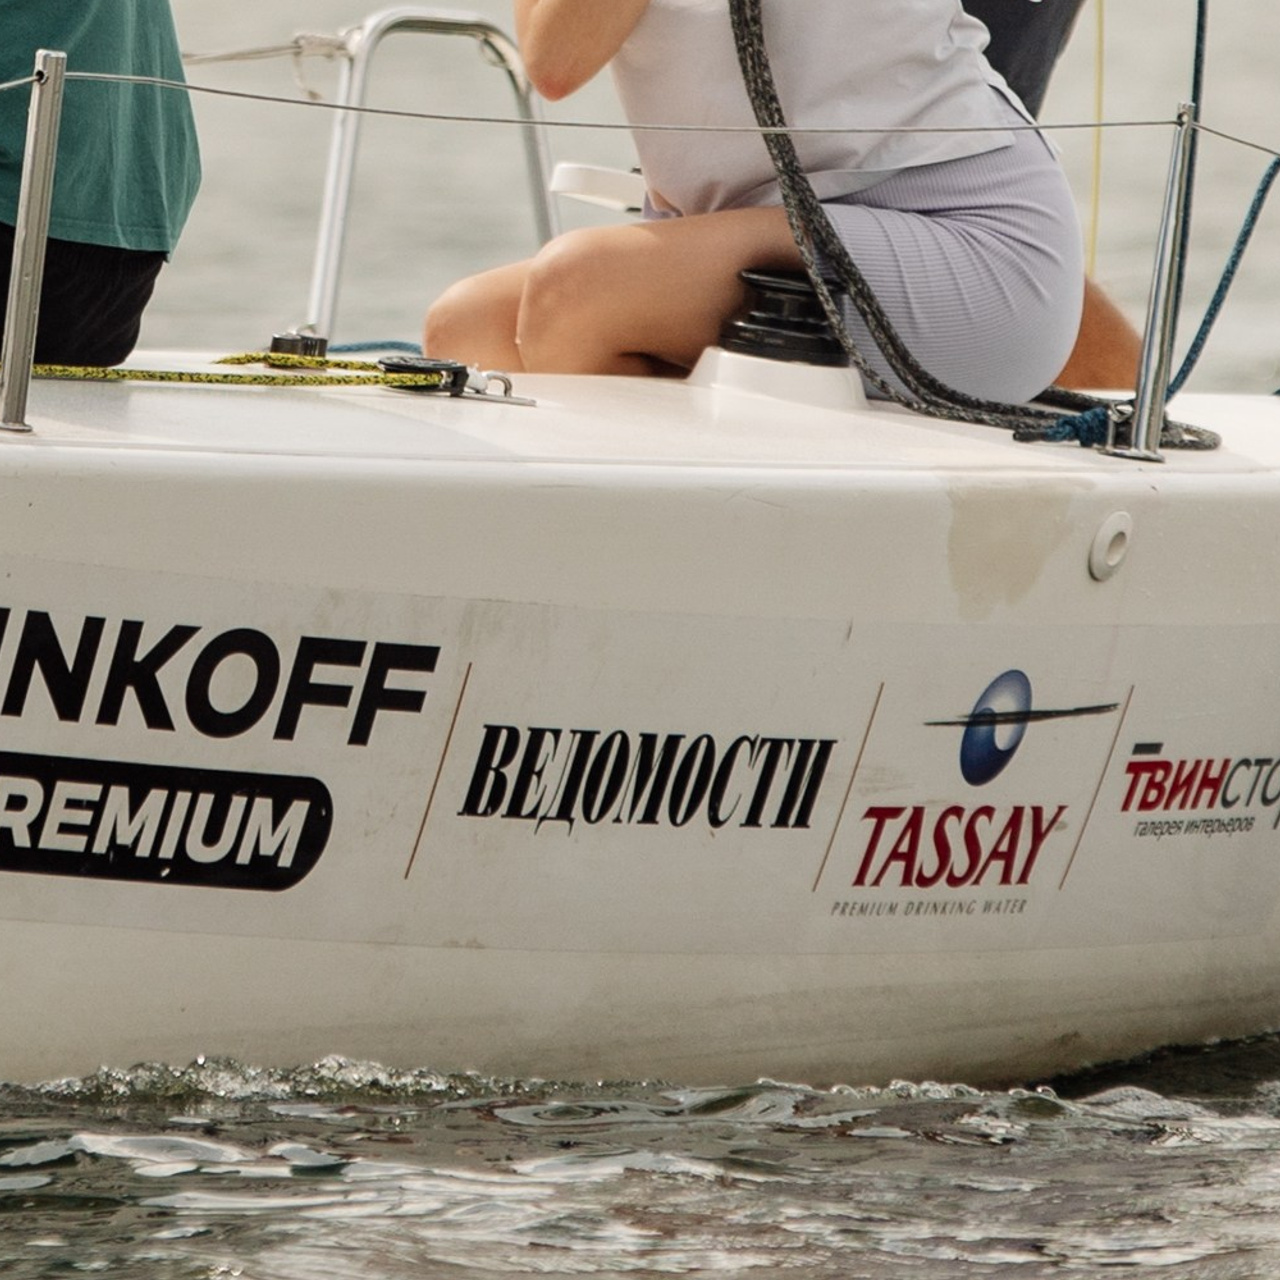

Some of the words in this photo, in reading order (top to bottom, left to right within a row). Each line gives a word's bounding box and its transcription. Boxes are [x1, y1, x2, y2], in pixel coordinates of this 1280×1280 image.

[456, 724, 838, 837] ВЕДОМОСТИ
[1121, 756, 1280, 830] ТВИНСТО
[852, 805, 1069, 888] TASSAY
[1133, 820, 1184, 841] галерея
[831, 901, 898, 916] PREMIUM
[904, 900, 976, 916] DRINKING
[982, 899, 1027, 915] WATER
